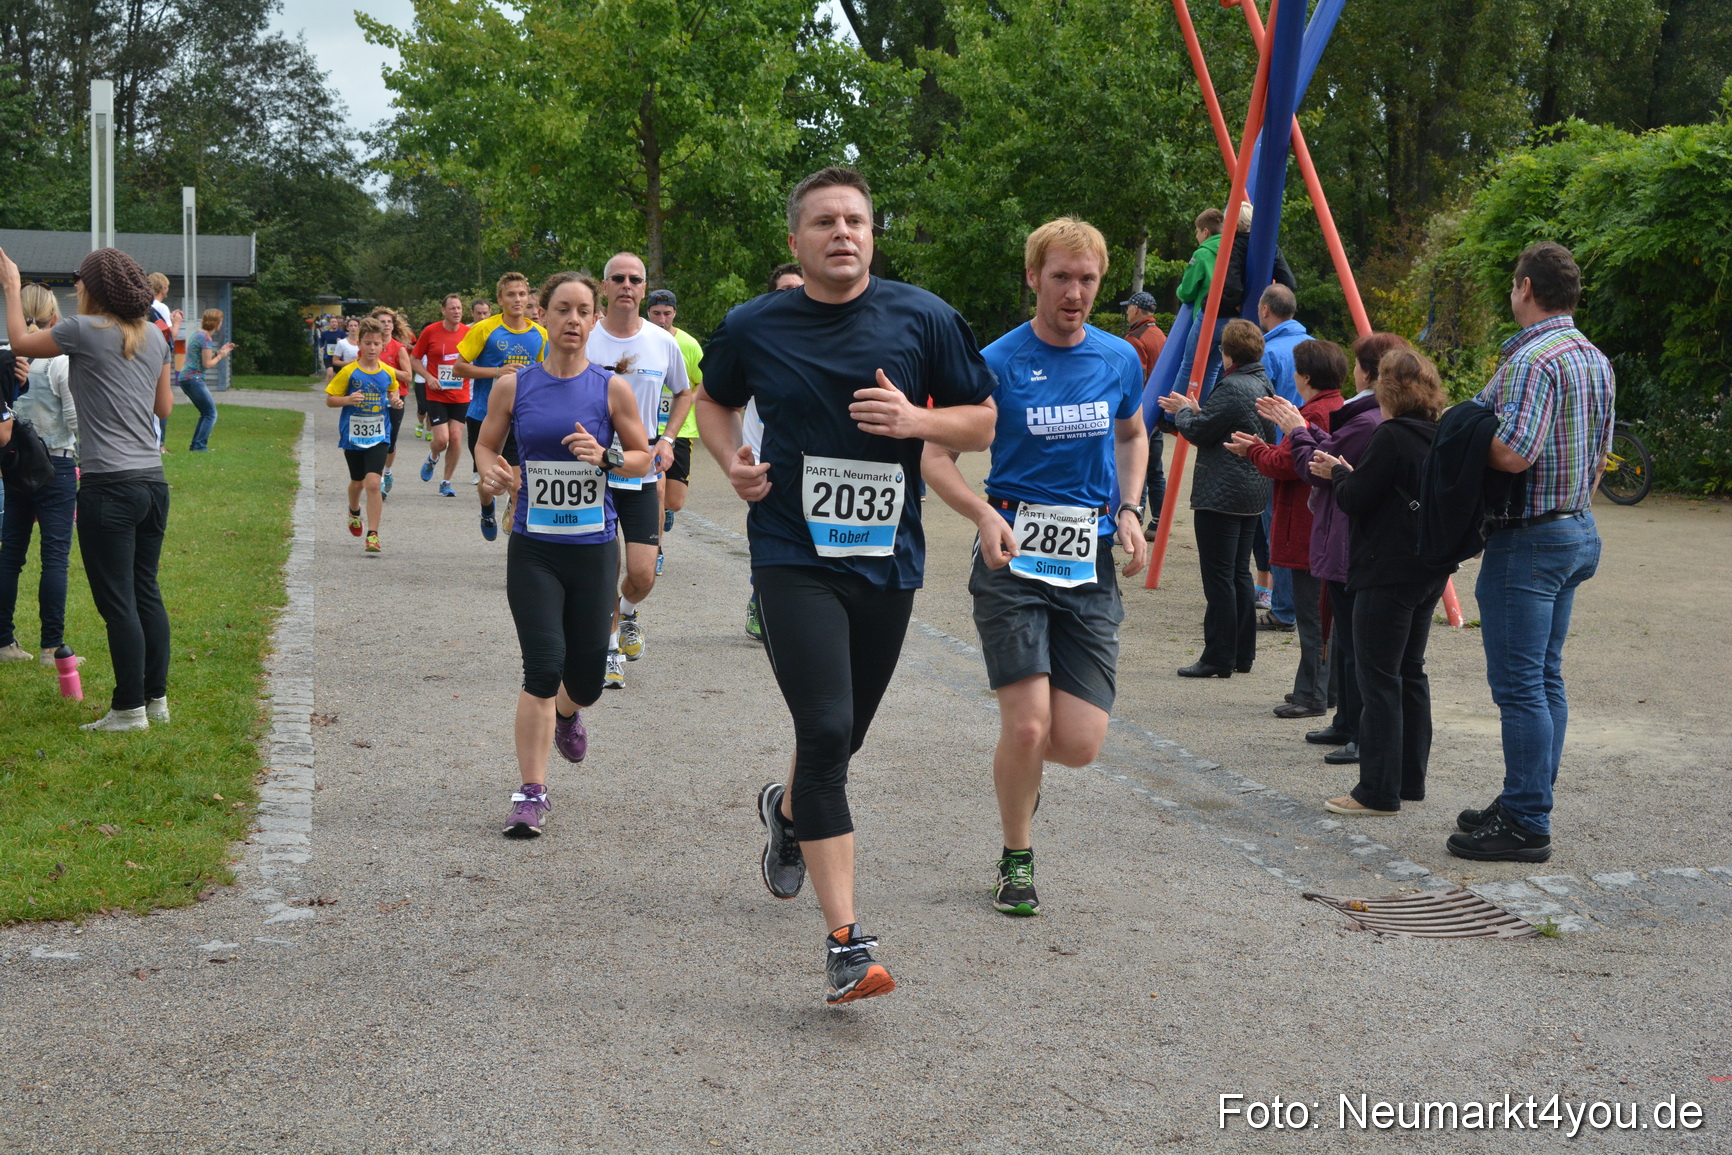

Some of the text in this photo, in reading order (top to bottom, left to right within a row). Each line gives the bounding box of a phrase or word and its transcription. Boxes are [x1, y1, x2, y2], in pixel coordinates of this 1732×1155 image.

[1026, 401, 1109, 426] HUBER
[353, 423, 381, 436] 3334
[1046, 420, 1107, 432] TECHNOLOGY
[528, 467, 592, 476] PARTL Neumarkt
[805, 465, 893, 482] PARTL Neumarkt
[535, 478, 598, 506] 2093
[811, 481, 896, 521] 2033
[552, 513, 578, 524] Jutta
[1018, 510, 1086, 523] PARTL Neumarkt
[828, 528, 870, 544] Robert
[1020, 521, 1091, 558] 2825
[1035, 560, 1071, 576] Simon
